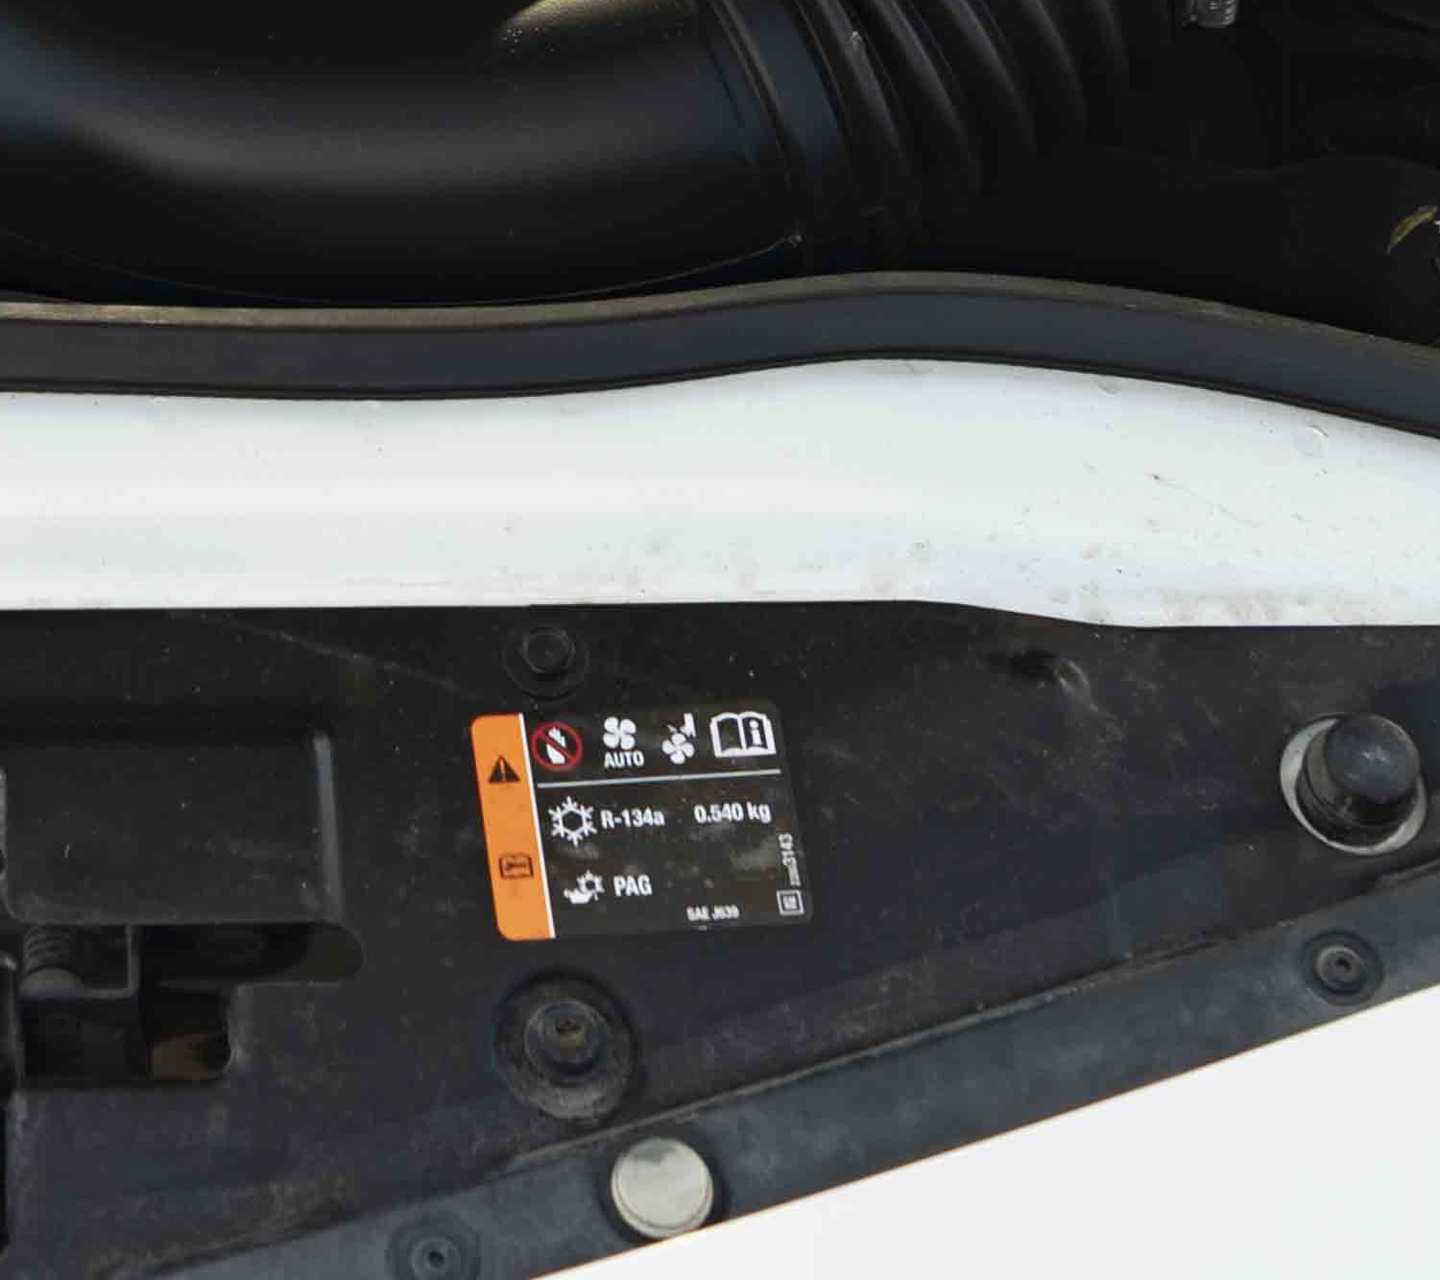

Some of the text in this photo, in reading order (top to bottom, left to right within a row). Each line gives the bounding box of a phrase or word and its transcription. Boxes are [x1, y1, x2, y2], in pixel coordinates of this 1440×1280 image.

[604, 751, 645, 769] AUTO
[600, 806, 665, 829] R-134a
[693, 801, 772, 824] 0.540 kg
[613, 875, 653, 897] PAG
[686, 906, 711, 921] SAE
